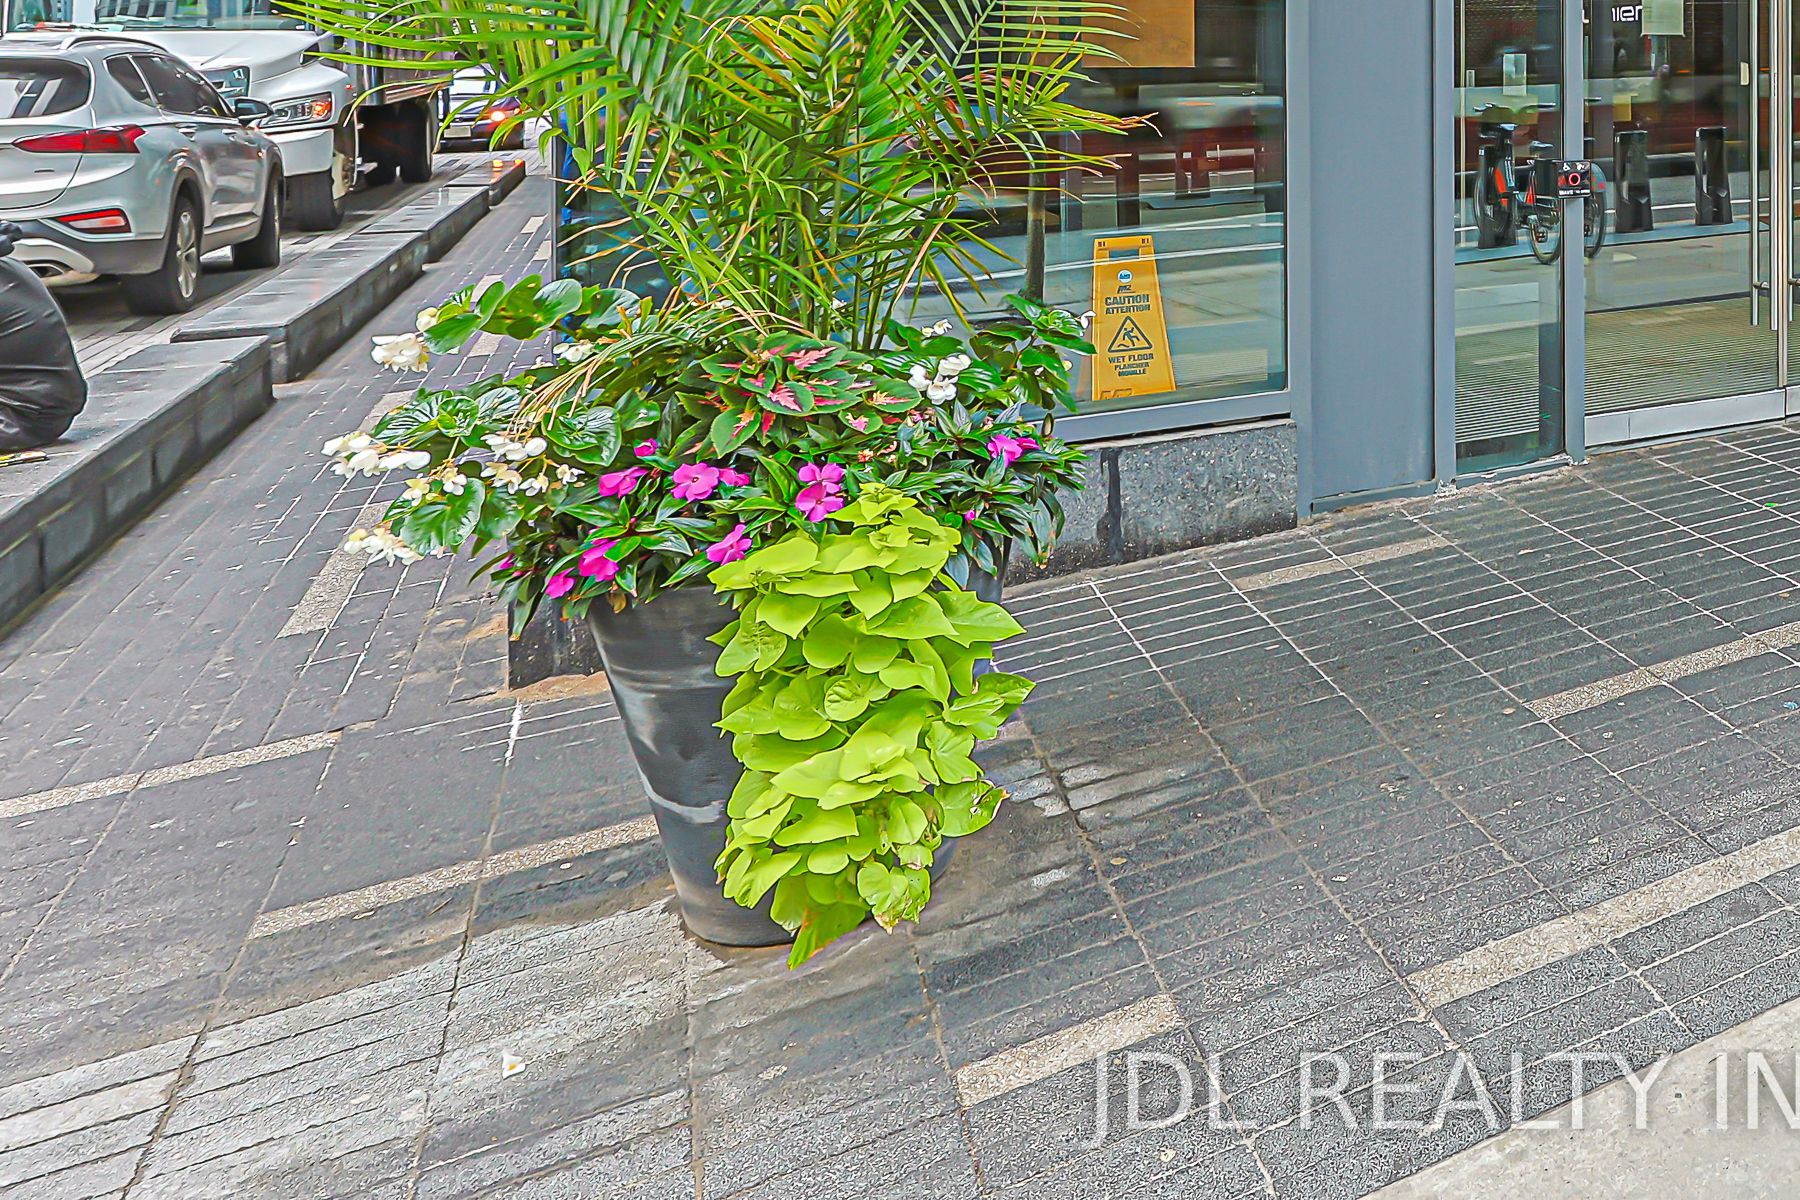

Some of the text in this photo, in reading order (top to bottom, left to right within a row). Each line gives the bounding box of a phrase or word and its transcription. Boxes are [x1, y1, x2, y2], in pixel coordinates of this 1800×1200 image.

[1105, 294, 1150, 307] CAUTION
[1105, 304, 1151, 315] ATTENTION
[1108, 353, 1154, 364] WET FLOOR
